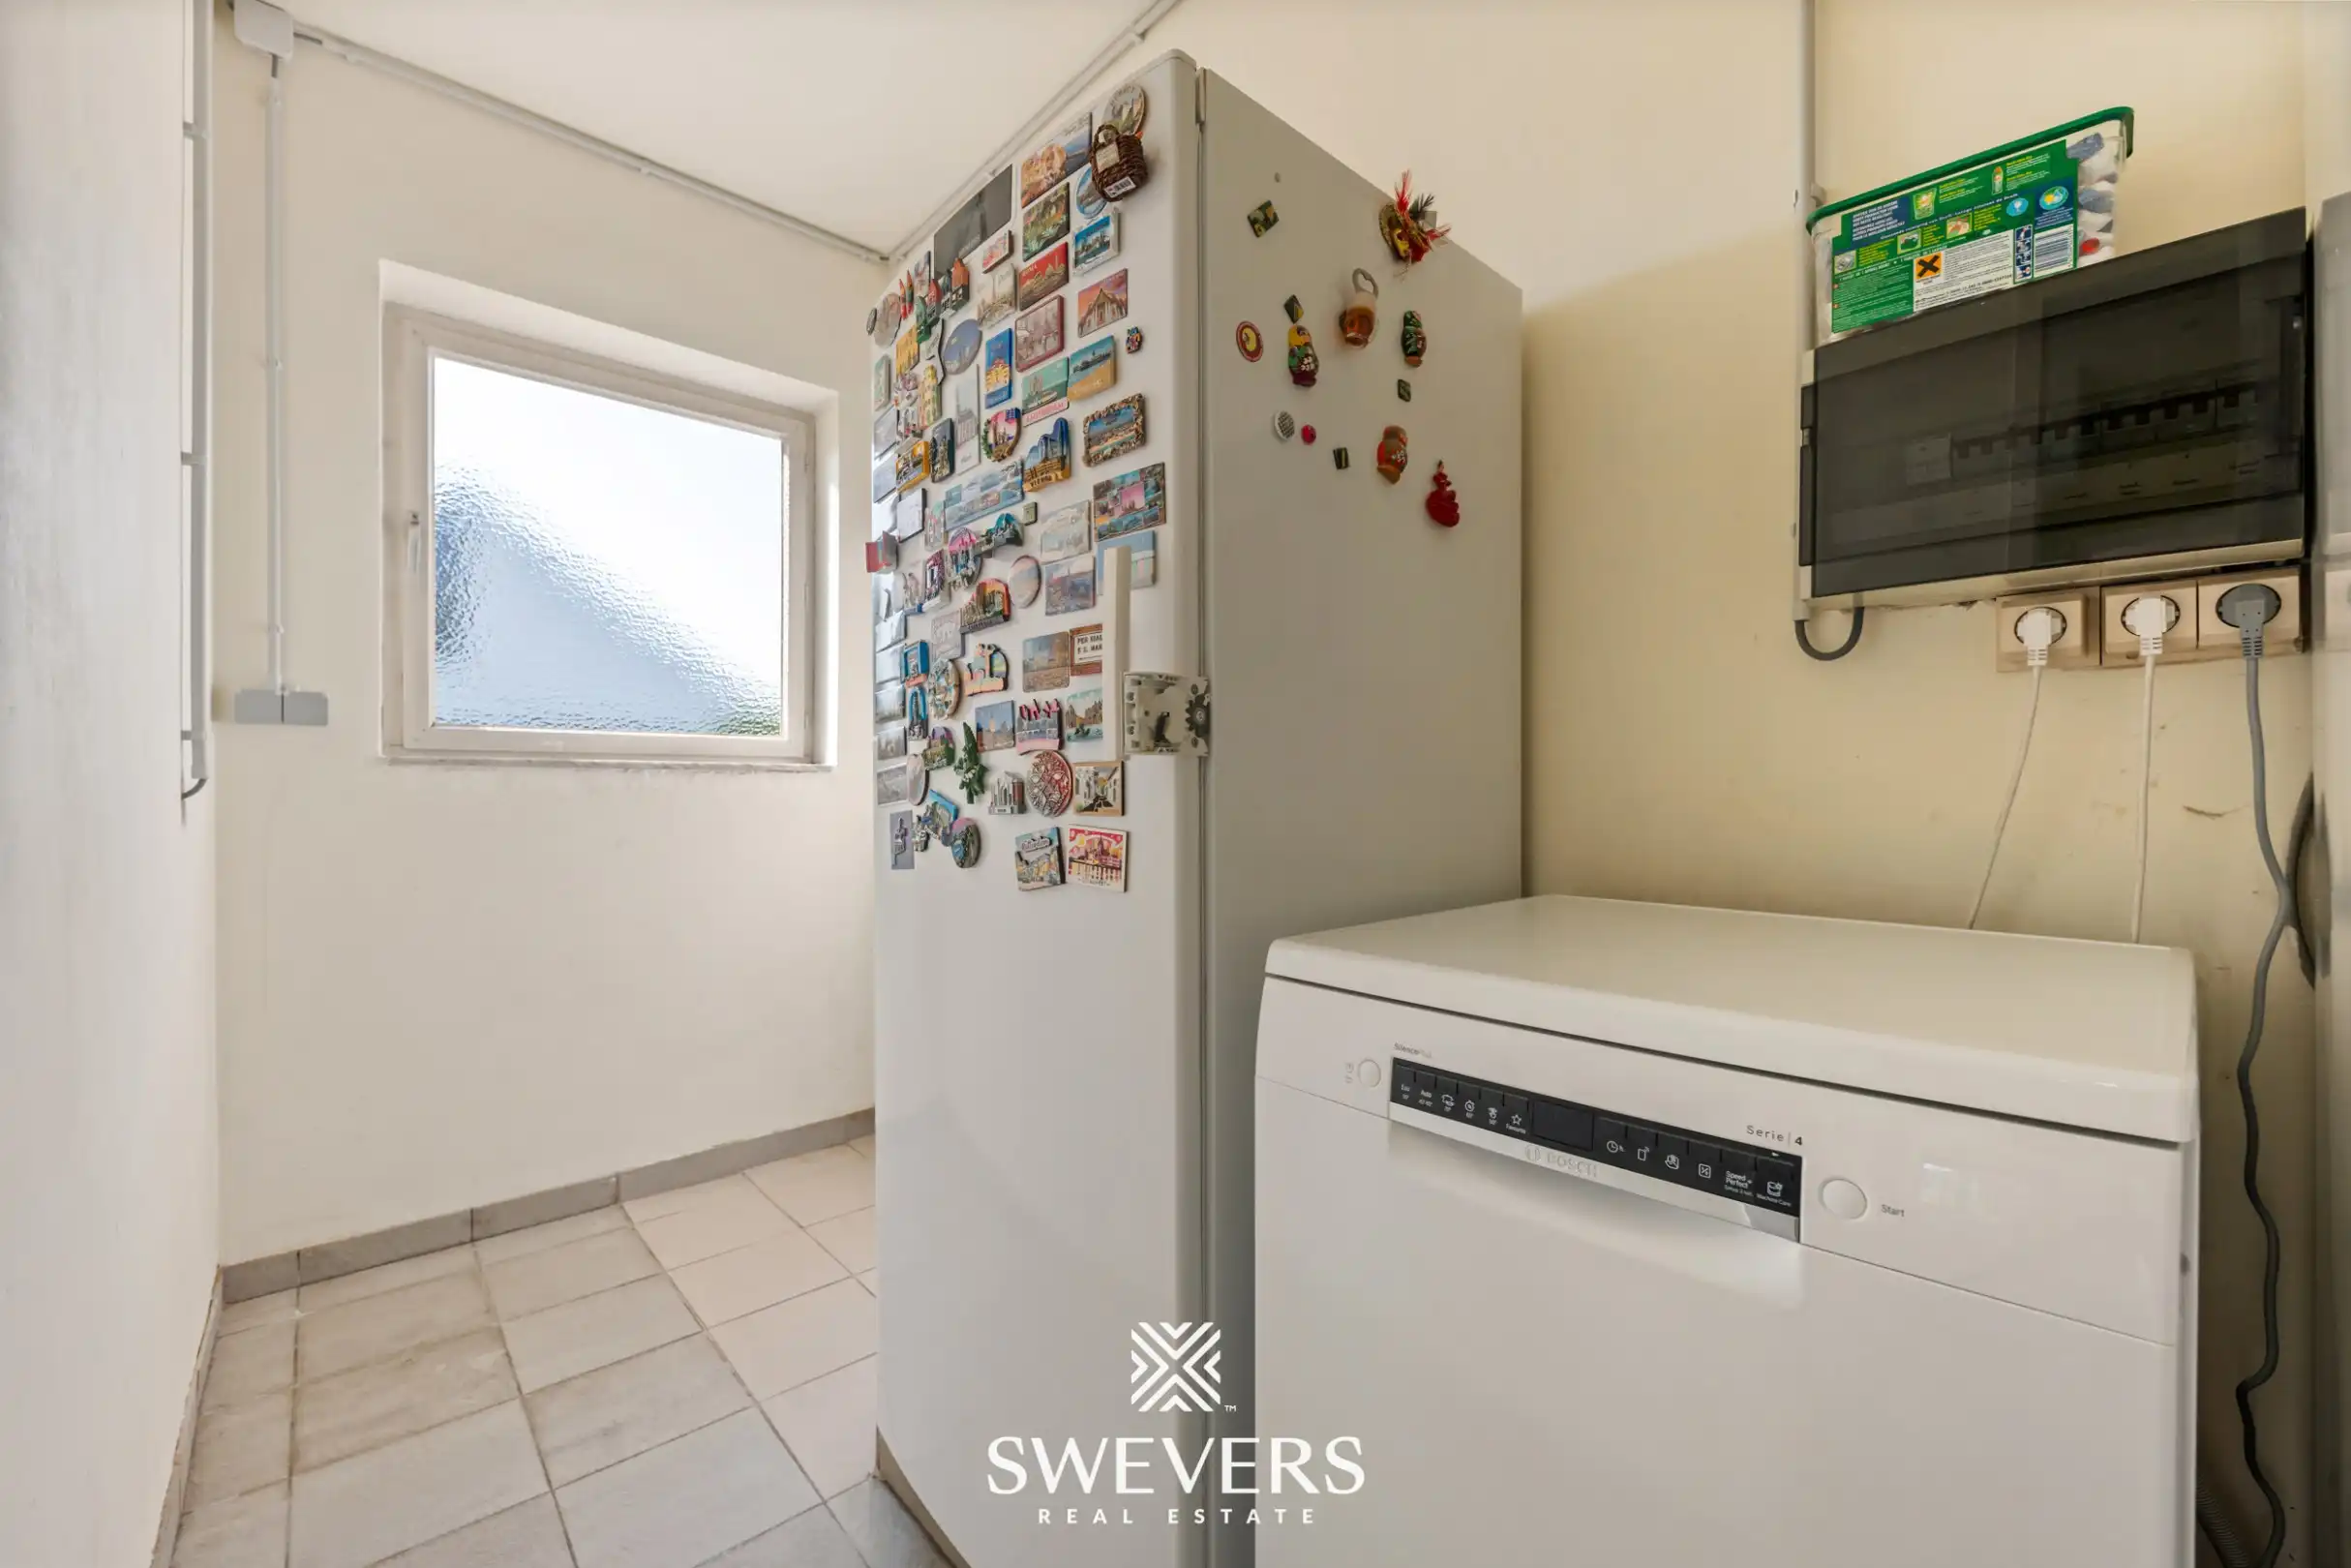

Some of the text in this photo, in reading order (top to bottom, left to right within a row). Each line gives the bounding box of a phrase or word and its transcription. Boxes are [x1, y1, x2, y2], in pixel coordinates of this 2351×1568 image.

[1746, 1125, 1803, 1147] Serie 4
[1726, 1170, 1747, 1182] Speed
[1881, 1203, 1905, 1218] Start
